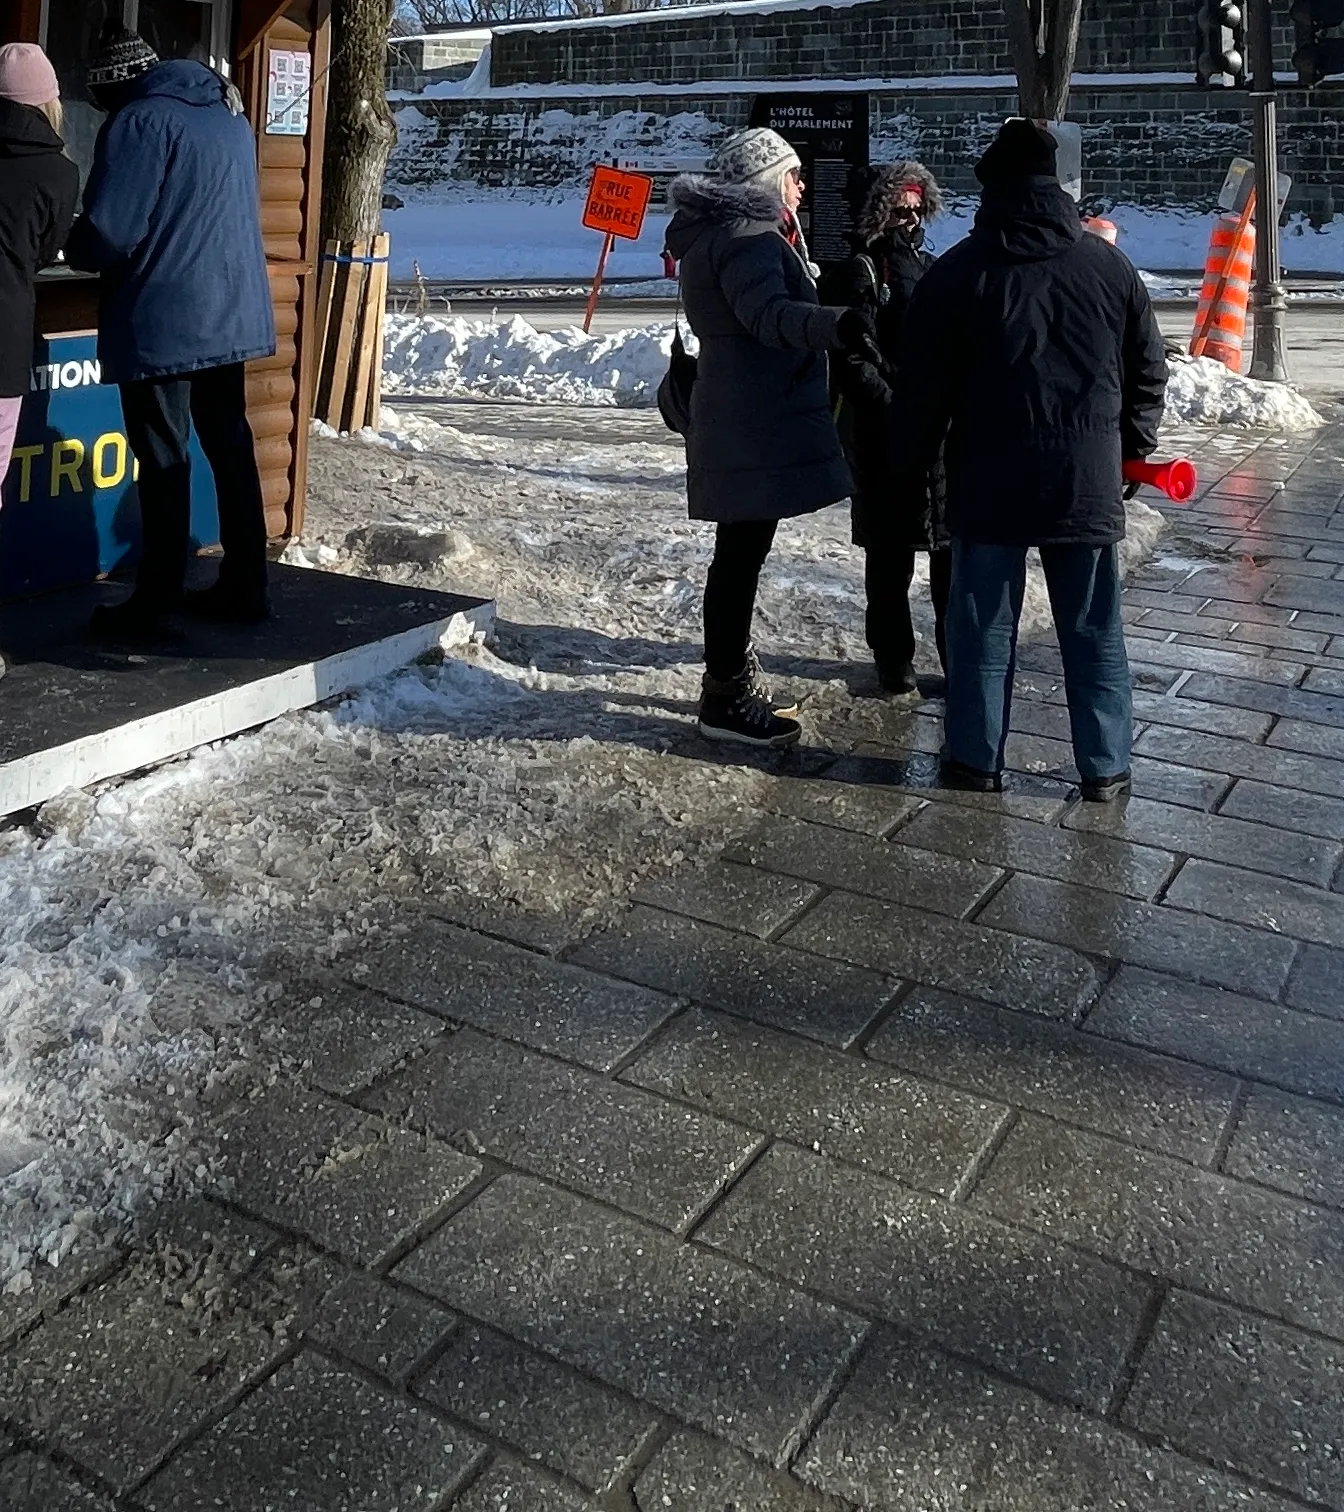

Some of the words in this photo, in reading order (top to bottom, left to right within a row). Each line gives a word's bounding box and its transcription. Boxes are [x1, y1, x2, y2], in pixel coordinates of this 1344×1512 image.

[770, 106, 814, 117] L'HÔTEL
[770, 119, 785, 128] DU
[788, 119, 854, 129] PARLEMENT
[606, 181, 634, 201] RUE
[590, 201, 640, 228] BARRÉE
